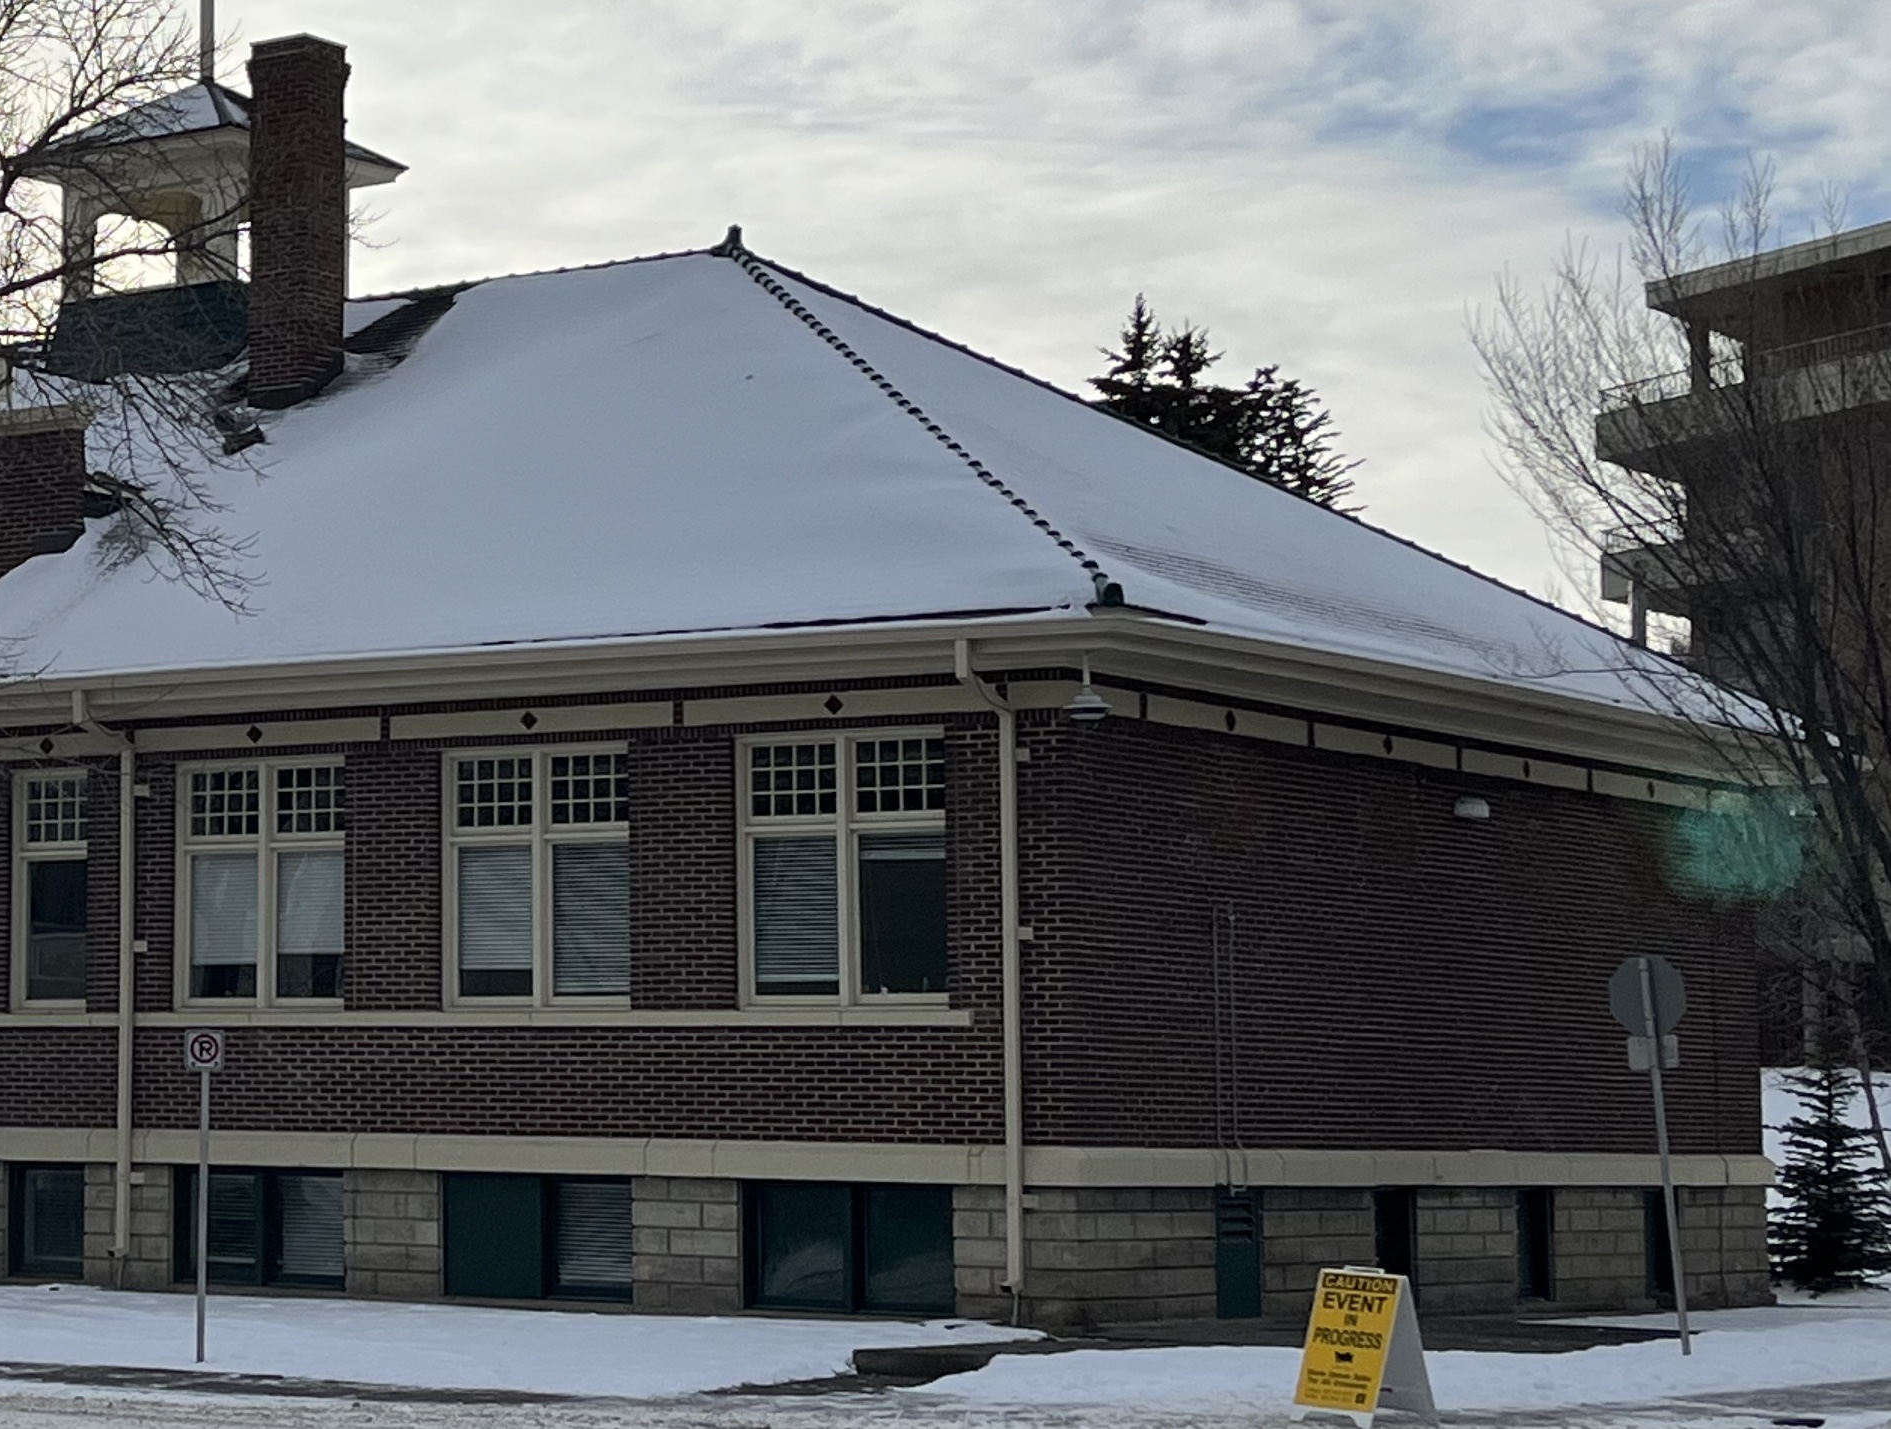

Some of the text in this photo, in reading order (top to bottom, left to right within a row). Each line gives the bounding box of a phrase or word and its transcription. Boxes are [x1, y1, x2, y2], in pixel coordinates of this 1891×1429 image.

[1325, 1274, 1395, 1292] CAUTION
[1323, 1291, 1388, 1314] EVENT
[1344, 1313, 1359, 1326] IN
[1312, 1326, 1383, 1350] PROGRESS
